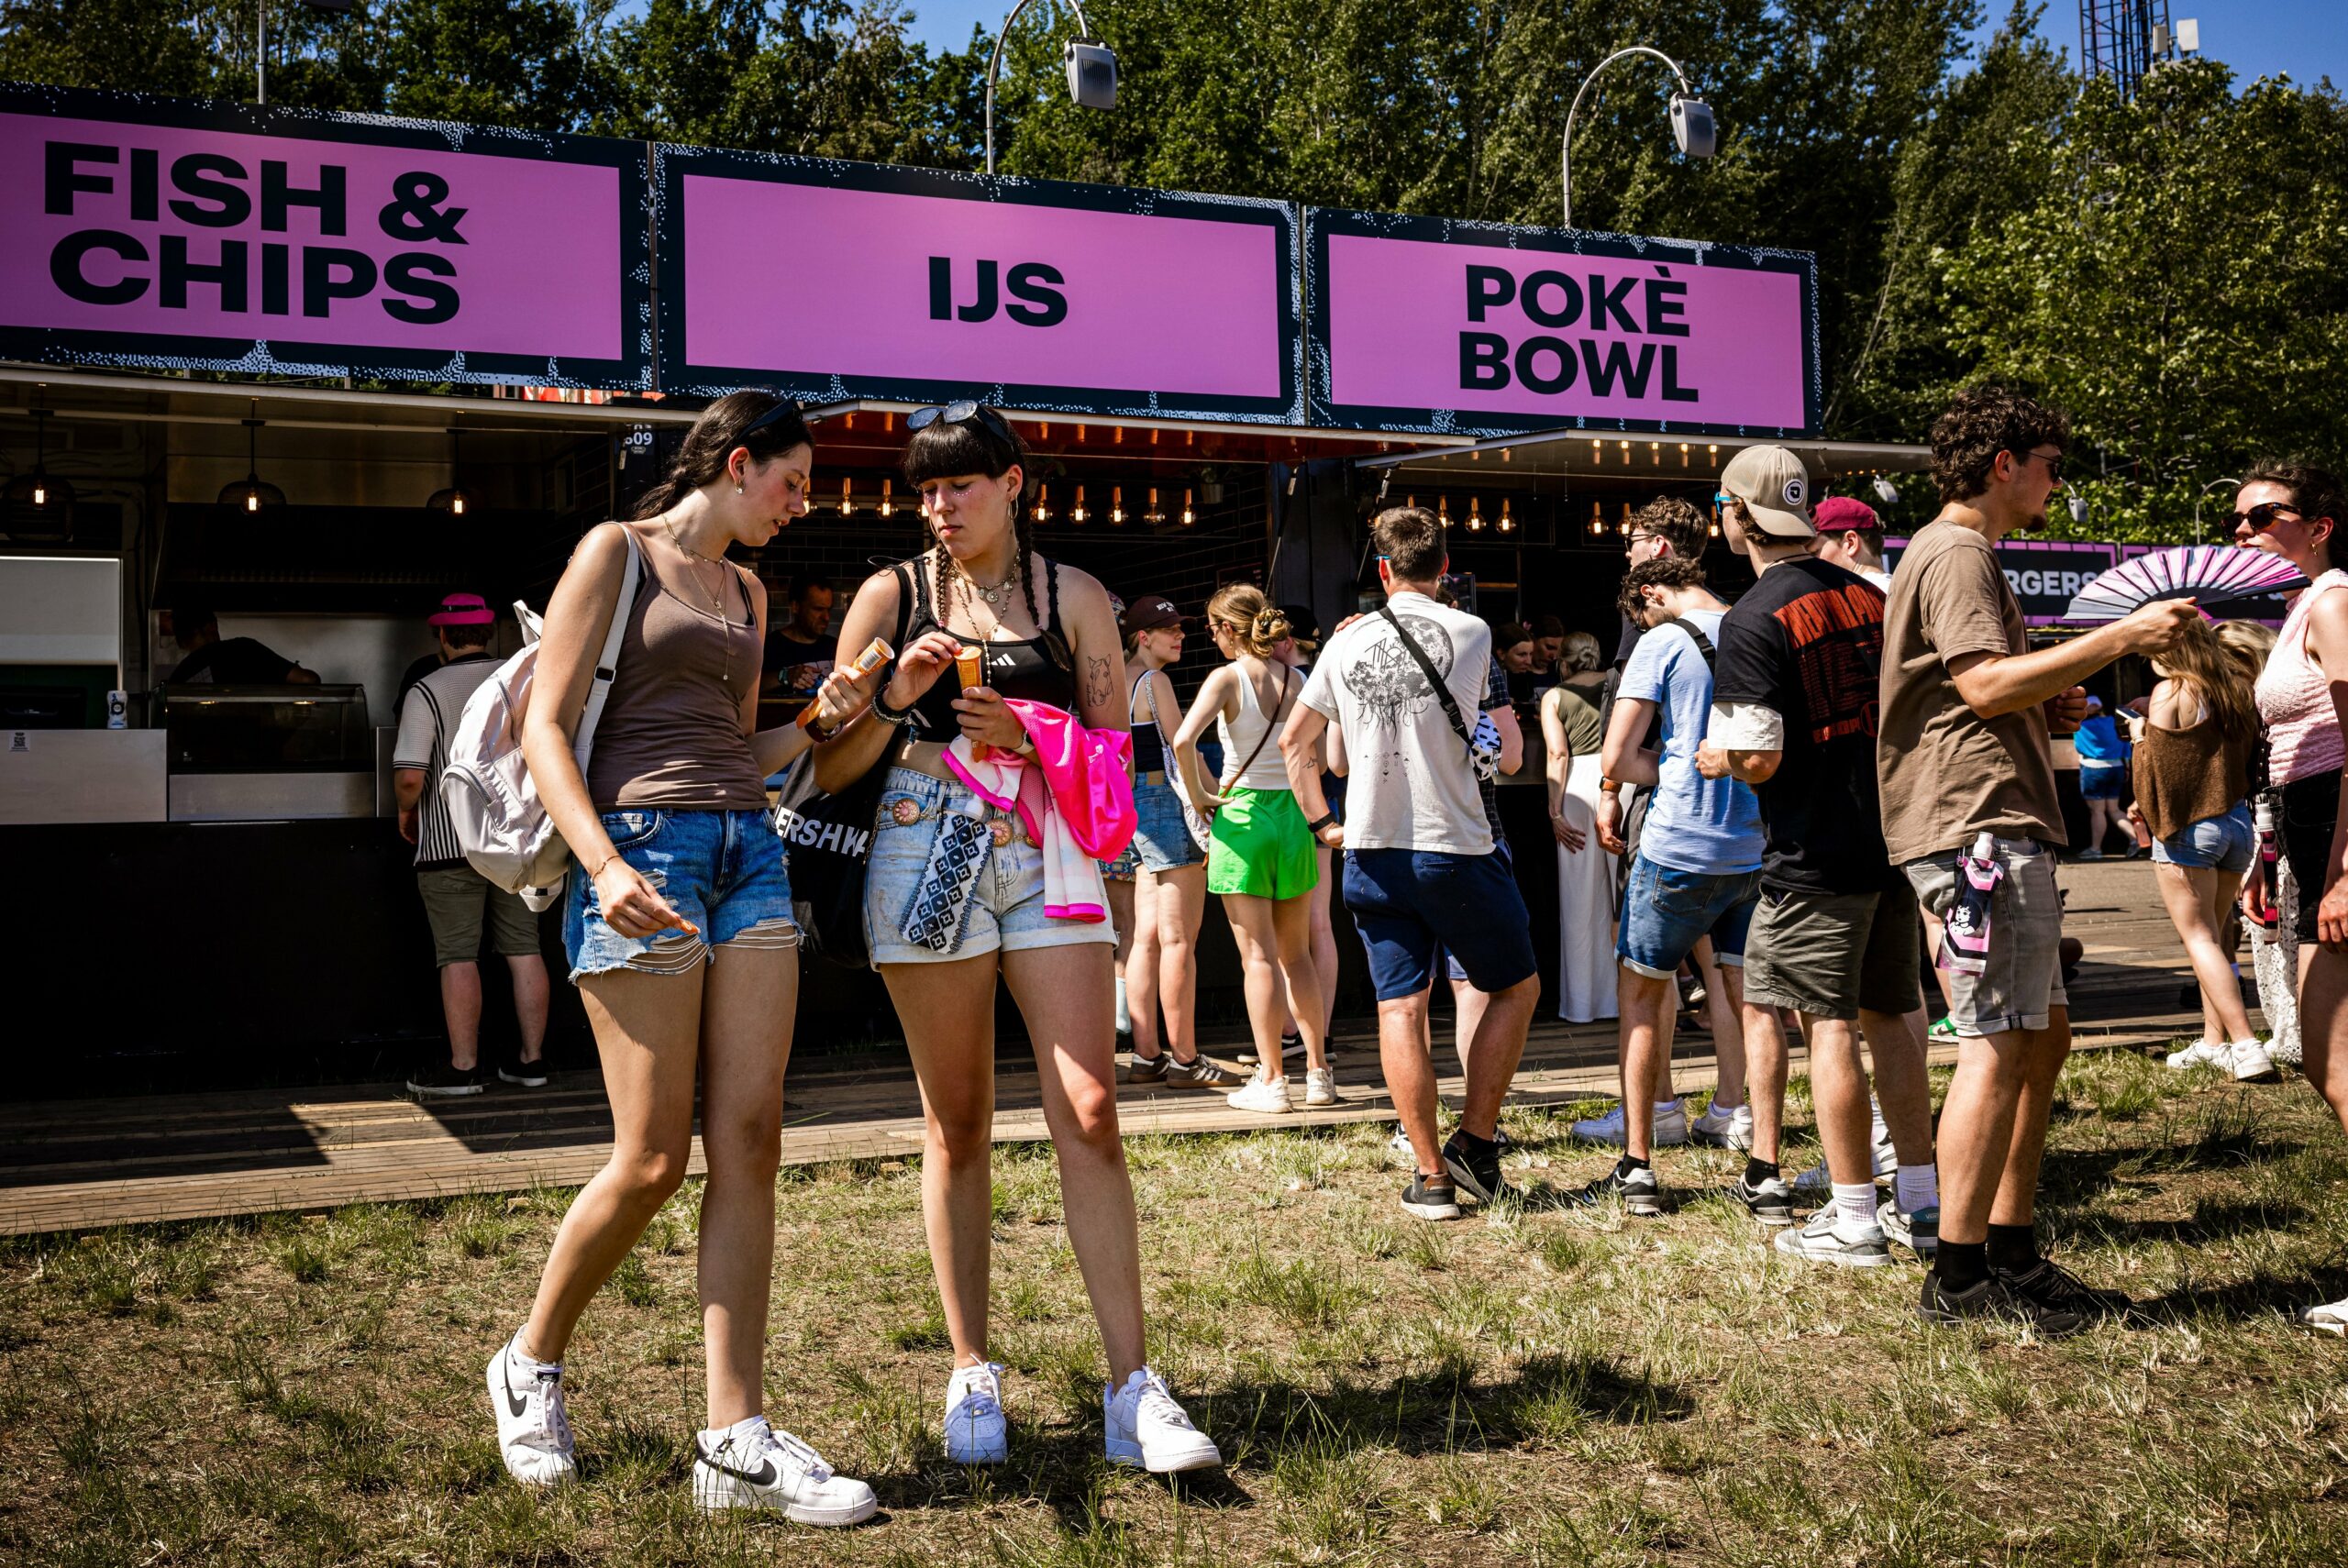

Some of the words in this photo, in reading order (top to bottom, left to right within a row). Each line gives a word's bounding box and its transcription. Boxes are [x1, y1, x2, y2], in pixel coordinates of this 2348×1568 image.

[45, 139, 346, 236] FISH
[379, 171, 469, 245] &
[50, 229, 460, 325] CHIPS
[928, 256, 1069, 327] IJS
[1466, 265, 1690, 337] POKÈ
[1459, 331, 1700, 403] BOWL
